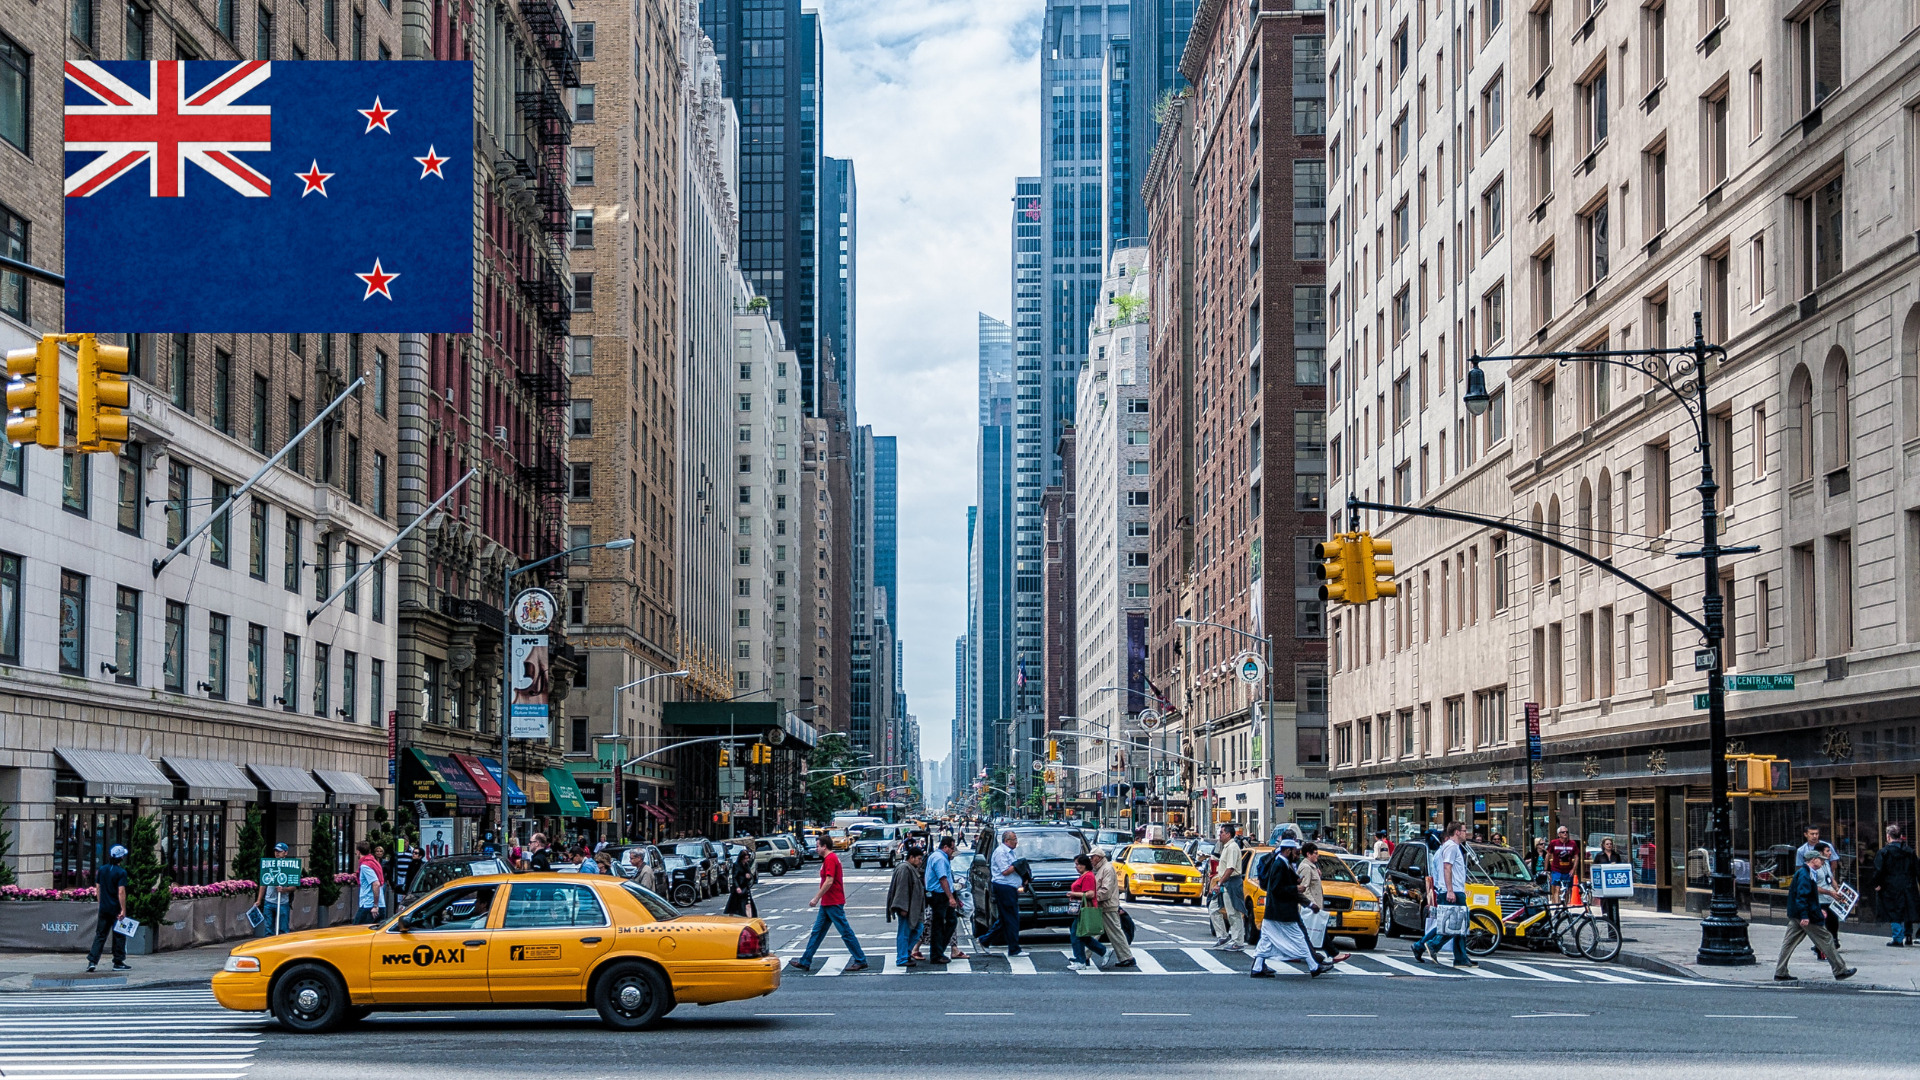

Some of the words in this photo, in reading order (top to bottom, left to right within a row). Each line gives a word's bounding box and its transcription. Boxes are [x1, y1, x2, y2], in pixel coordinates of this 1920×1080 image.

[1736, 676, 1772, 685] CENTRAL
[1773, 675, 1794, 685] PARK
[261, 859, 276, 869] BIKE
[276, 859, 300, 869] RENTAL
[1606, 878, 1629, 886] TODAY
[41, 923, 79, 932] MARKET
[382, 954, 412, 965] NYC
[412, 944, 465, 967] TAXI
